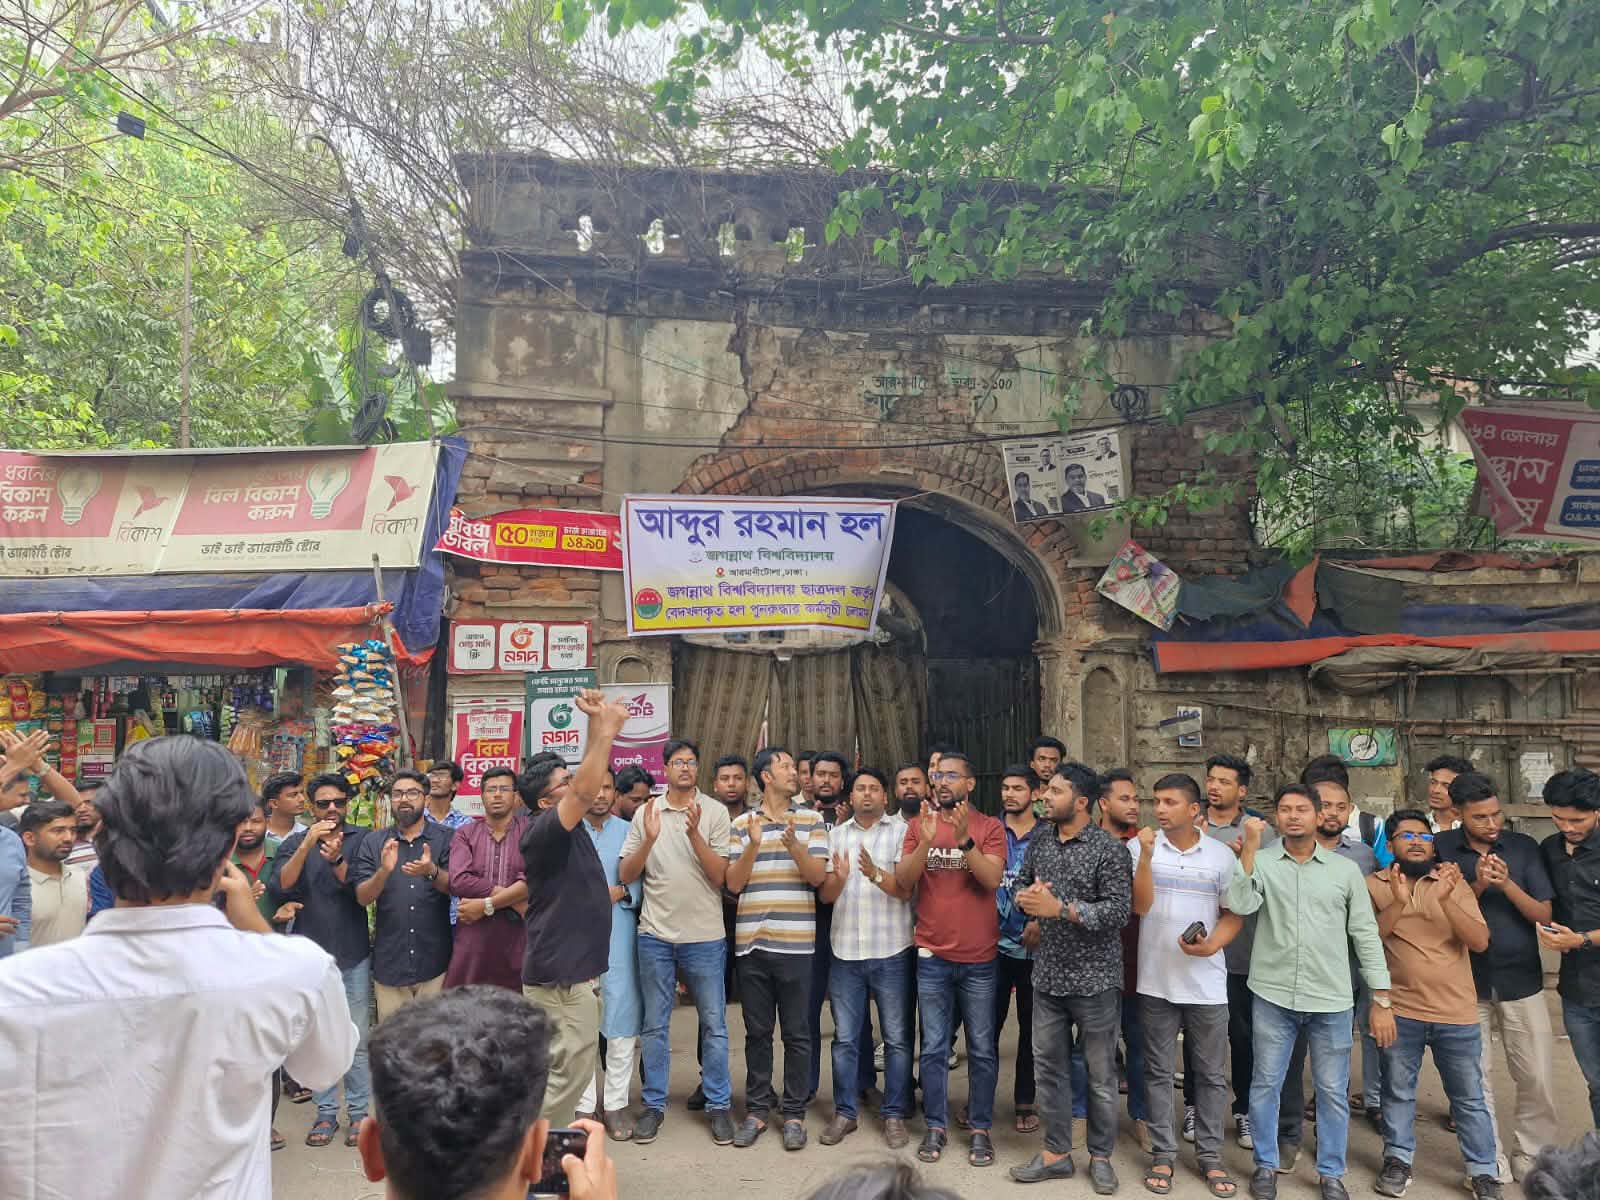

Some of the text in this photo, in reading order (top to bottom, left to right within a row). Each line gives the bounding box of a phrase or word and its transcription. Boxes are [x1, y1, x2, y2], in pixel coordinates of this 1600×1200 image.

[1501, 428, 1560, 447] জেলায়
[0, 481, 53, 502] বিকাশ
[203, 484, 302, 504] বিল বিকাশ
[3, 506, 49, 522] করুন
[247, 503, 297, 520] করুন
[116, 521, 163, 544] বিকাশ
[370, 514, 418, 535] বিকাশ
[634, 506, 725, 548] আব্দুর
[732, 508, 829, 541] রহমান
[837, 512, 886, 541] হল
[442, 531, 491, 553] ডাবল
[499, 525, 529, 545] ৫০
[567, 537, 604, 550] ১৪.৯০
[201, 543, 222, 554] ভাই
[225, 541, 245, 554] ভাই
[705, 547, 835, 562] জগন্নাথ বিশ্ববিদ্যালয়
[665, 584, 713, 599] জগন্নাথ
[718, 581, 796, 596] বিশ্ববিদ্যালয়
[800, 584, 846, 596] ছাত্রদল
[728, 605, 746, 617] হল
[504, 650, 539, 663] নগদ
[542, 730, 579, 744] নগদ
[475, 738, 509, 757] বিল
[461, 753, 516, 773] বিকাশ
